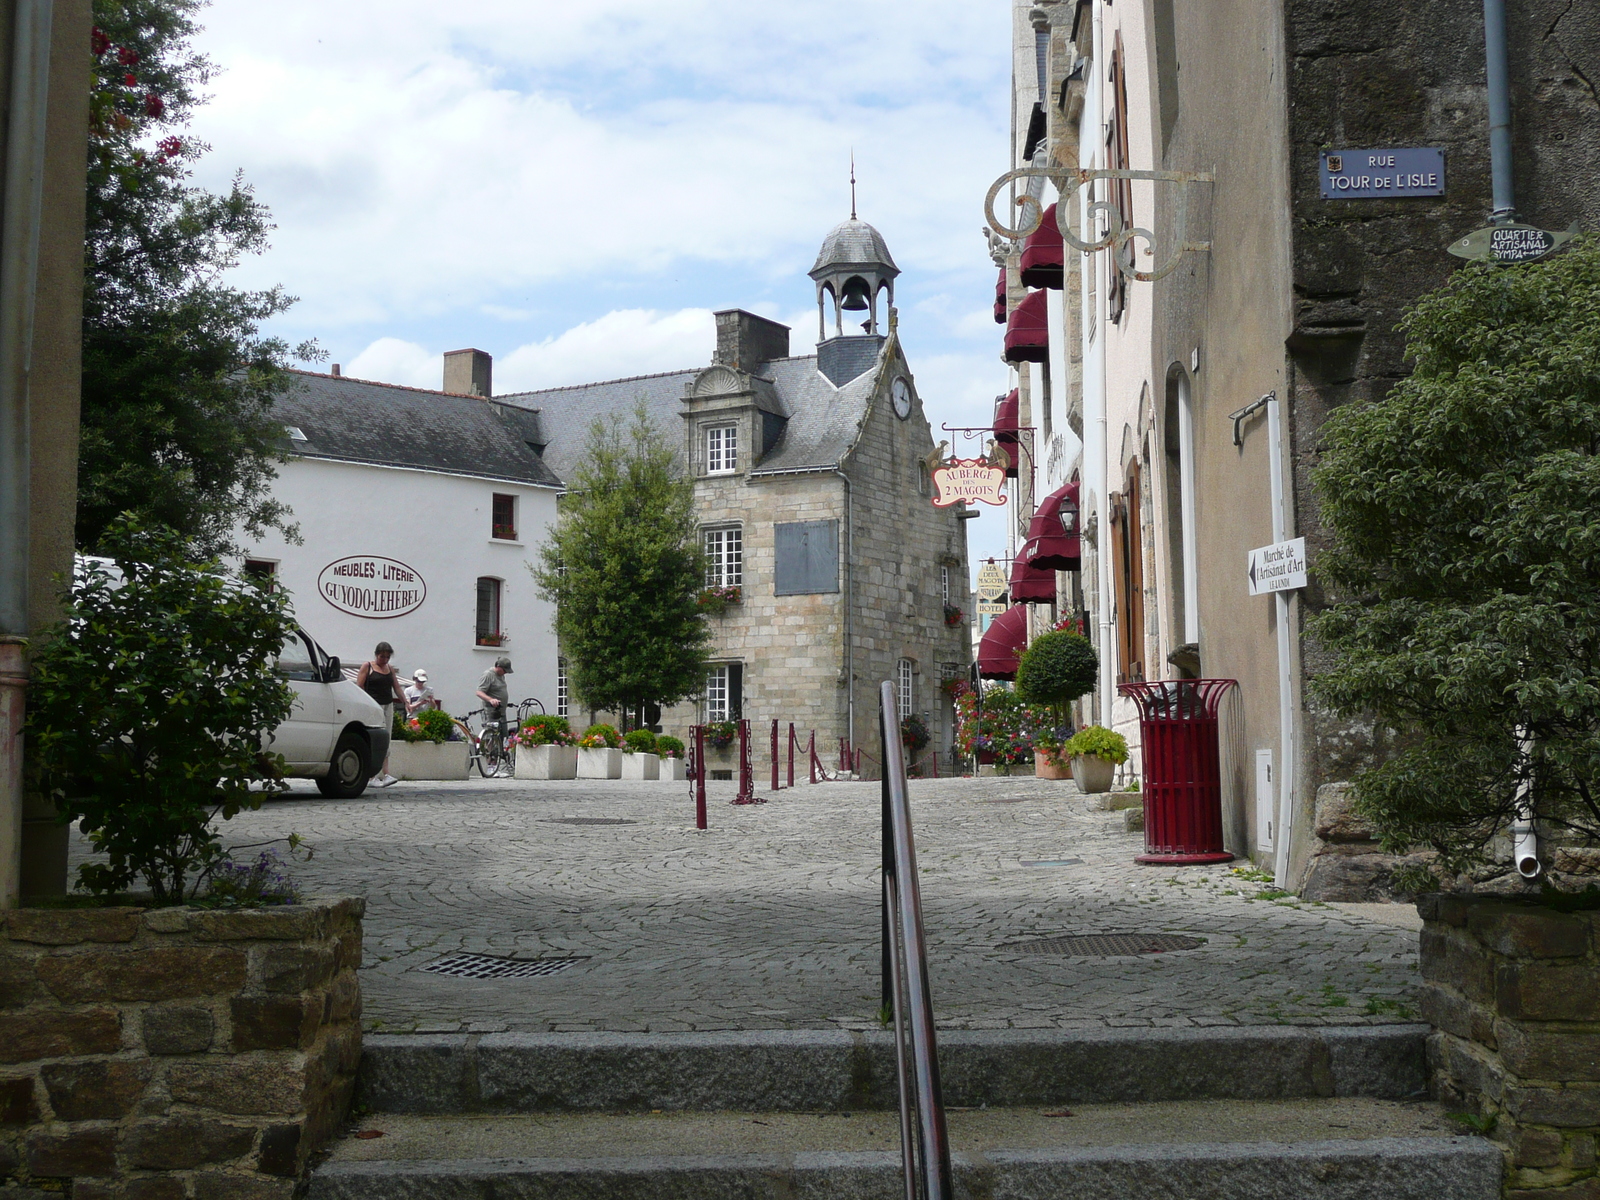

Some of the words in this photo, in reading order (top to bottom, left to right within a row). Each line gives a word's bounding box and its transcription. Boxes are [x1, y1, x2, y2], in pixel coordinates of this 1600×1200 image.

[1368, 155, 1395, 167] RUE
[1329, 175, 1370, 190] TOUR
[1374, 177, 1391, 188] DE
[1396, 173, 1437, 187] L'ISLE
[1493, 229, 1544, 240] QUARTIER
[1491, 240, 1548, 250] ARTISANAL
[1493, 249, 1524, 260] SYMPA
[946, 469, 994, 481] AUBERGE
[945, 485, 951, 496] 2
[953, 485, 994, 496] MAGOTS
[1263, 546, 1284, 564] Marché
[1285, 545, 1294, 558] de
[333, 562, 375, 579] MEUBLES
[383, 563, 414, 582] LITERIE
[1256, 562, 1286, 580] l'Artisanat
[1287, 558, 1304, 573] d'Art
